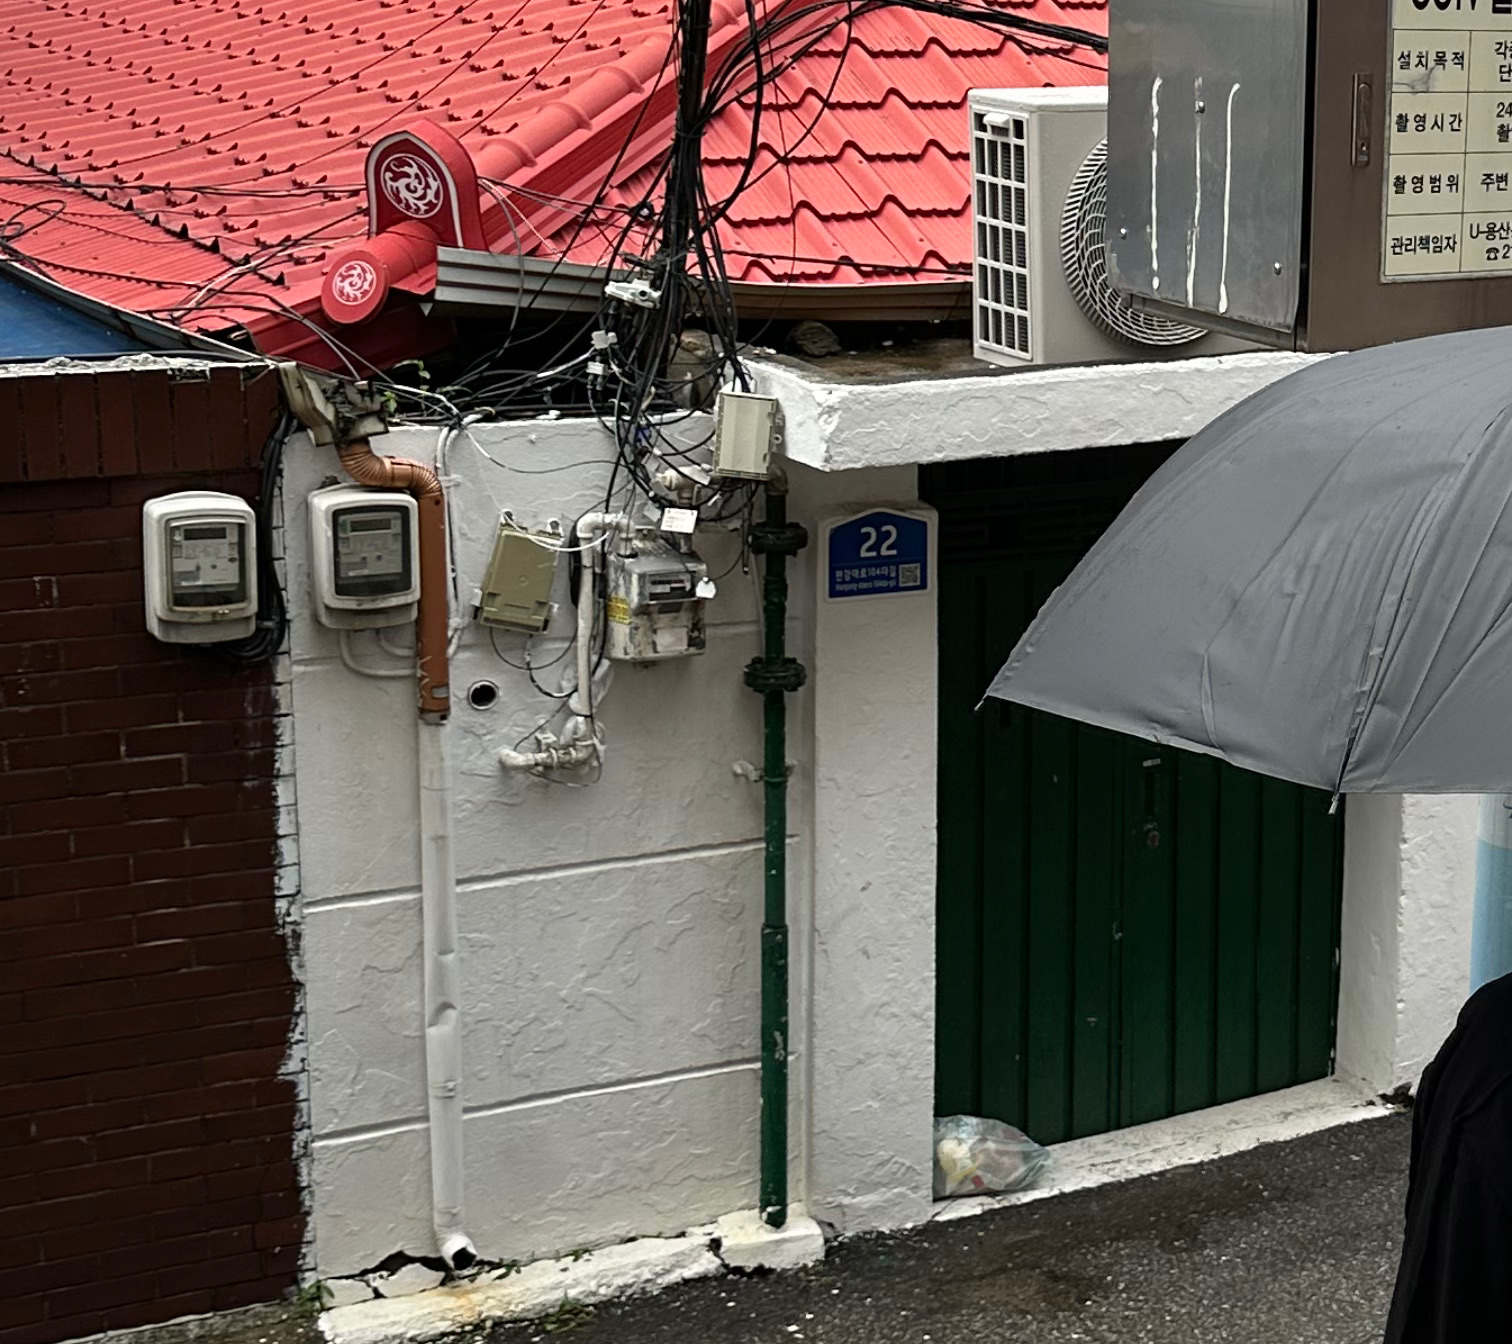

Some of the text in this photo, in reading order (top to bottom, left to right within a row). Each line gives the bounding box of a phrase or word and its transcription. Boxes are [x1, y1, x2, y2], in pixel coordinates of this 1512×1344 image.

[1480, 172, 1509, 192] 주변
[1390, 233, 1457, 256] 관리책임자
[860, 524, 898, 558] 22
